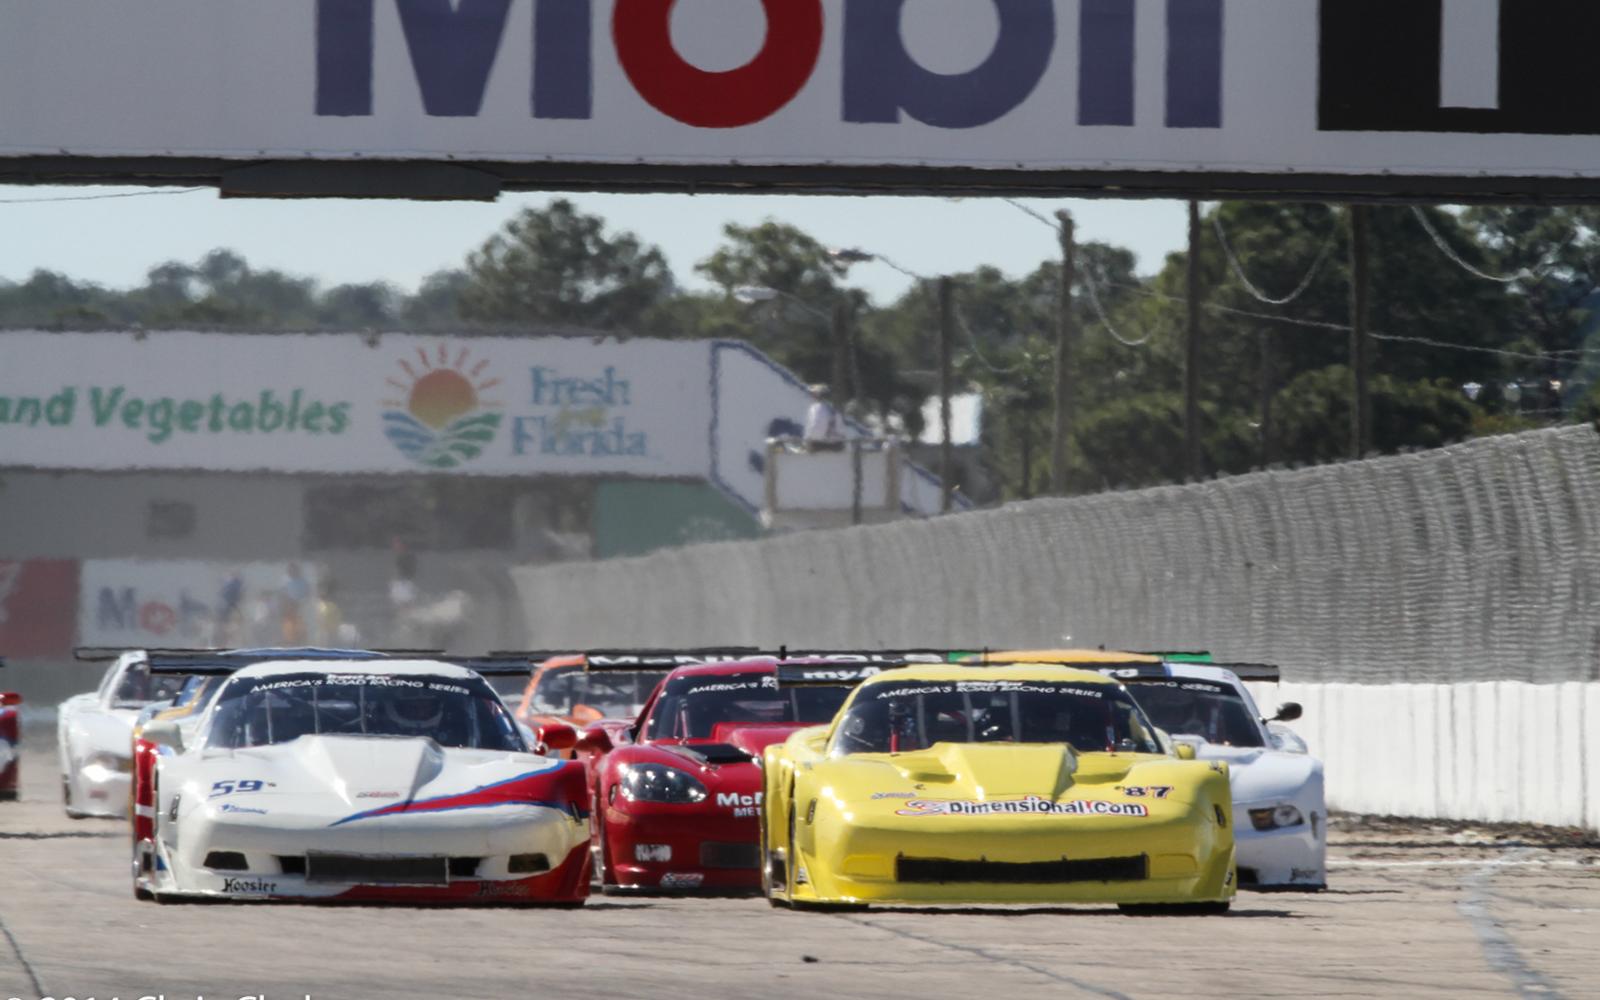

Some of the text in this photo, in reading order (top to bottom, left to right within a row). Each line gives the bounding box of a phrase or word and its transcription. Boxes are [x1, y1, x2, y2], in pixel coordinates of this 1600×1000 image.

[529, 365, 631, 405] Fresh
[89, 385, 350, 444] Vegetables
[250, 679, 321, 693] AMERICA'S
[370, 678, 424, 688] RACING
[428, 682, 470, 695] SERIES
[688, 681, 759, 695] AMERICA'S
[877, 686, 952, 700] AMERICA'S
[1058, 687, 1104, 698] SERIES
[209, 779, 264, 798] 59
[222, 877, 277, 894] Hoosier
